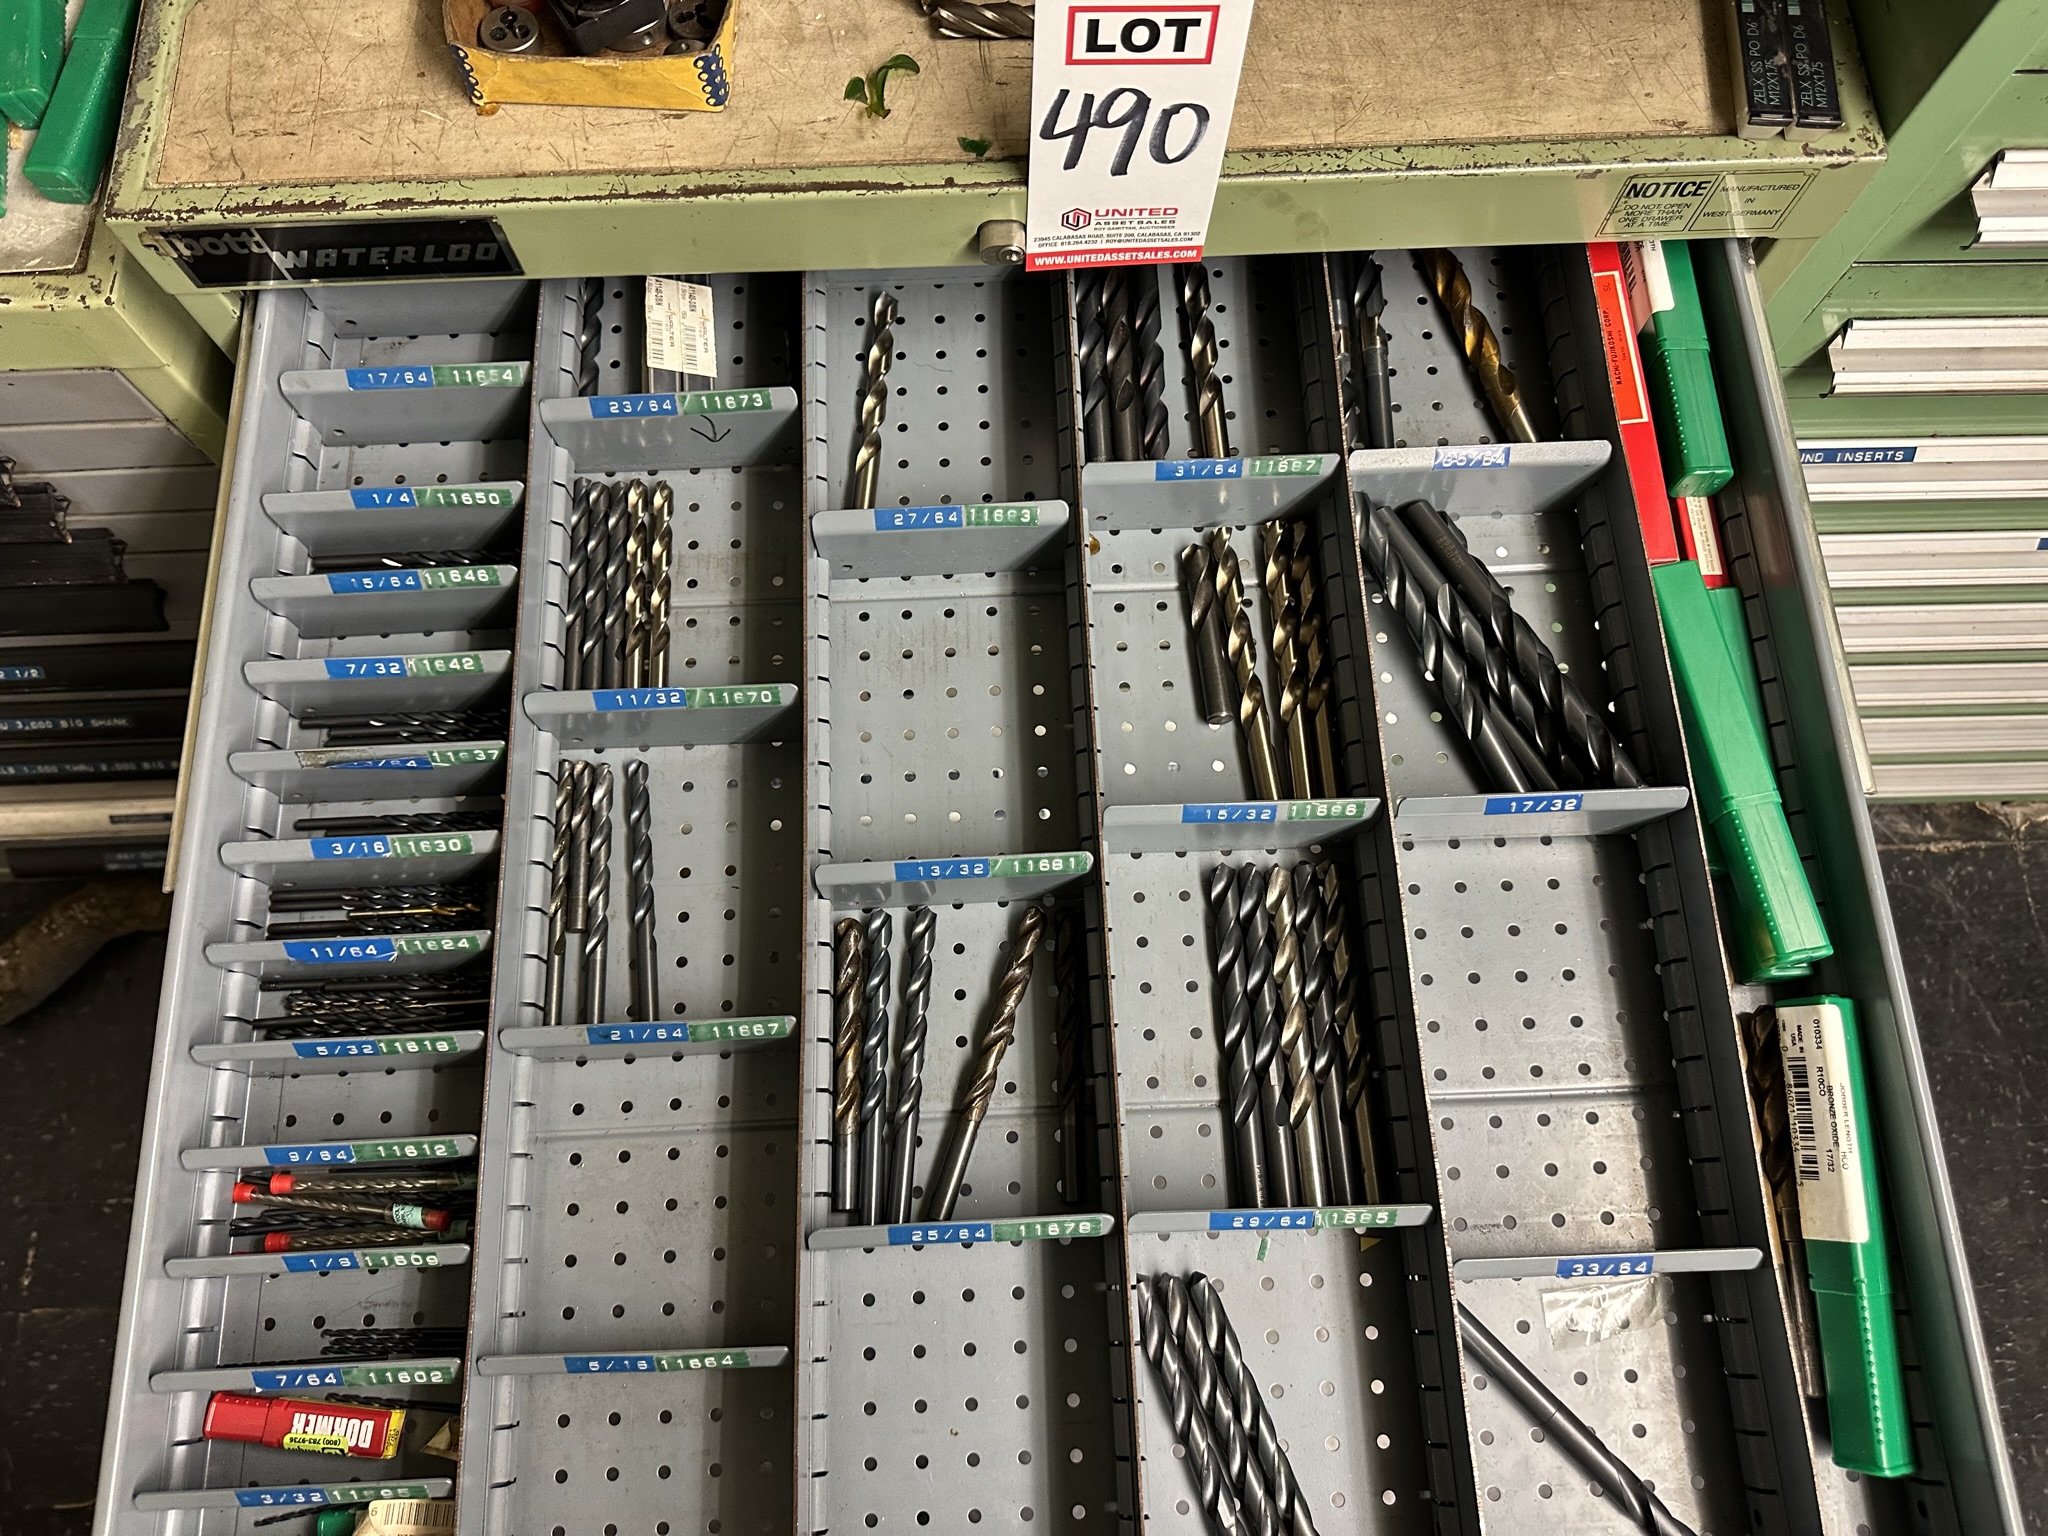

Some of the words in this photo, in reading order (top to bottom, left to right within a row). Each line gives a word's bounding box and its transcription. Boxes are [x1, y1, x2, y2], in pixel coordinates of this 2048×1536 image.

[1085, 18, 1202, 53] LOT
[1746, 21, 1759, 36] D6
[1793, 24, 1805, 39] D6
[1748, 40, 1760, 57] PO
[1795, 43, 1808, 59] PO
[1751, 61, 1762, 73] SS
[1797, 64, 1811, 76] SS
[1765, 59, 1781, 105] M12X1.75
[1811, 61, 1828, 108] M12X1.75
[1753, 78, 1767, 105] ZELX
[1800, 80, 1814, 107] ZELX
[1038, 87, 1210, 177] 490
[1625, 180, 1712, 198] NOTICE
[1720, 184, 1801, 192] MANUFACTURED
[1094, 207, 1179, 217] UNITED
[1641, 214, 1684, 222] DRAWER
[1733, 209, 1782, 217] GERMANY
[272, 243, 499, 269] WATERLOO
[1034, 250, 1197, 266] WWW.UNITEDASSETSALES.COM
[1603, 307, 1612, 327] CORP.
[1608, 330, 1623, 385] NACHI-FUJIKOSHI
[367, 372, 428, 384] 17/64
[609, 399, 672, 413] 23/64
[701, 394, 763, 409] 11673
[1835, 451, 1904, 462] INSERTS
[1175, 463, 1237, 477] 31/64
[372, 492, 410, 504] 1/4
[436, 492, 499, 504] 11650
[894, 511, 958, 525] 27/64
[351, 576, 415, 589] 15/64
[424, 570, 489, 585] 11646
[345, 662, 401, 675] 7/32
[410, 658, 475, 673] 11642
[615, 692, 680, 706] 11/32
[708, 690, 772, 704] 11670
[1510, 798, 1577, 812] 17/32
[1205, 808, 1271, 820] 15/32
[331, 841, 385, 855] 3/16
[393, 839, 461, 853] 11630
[918, 863, 984, 876] 13/32
[1013, 857, 1075, 873] 11681
[310, 944, 378, 958] 11/64
[399, 938, 470, 951] 11624
[610, 1027, 683, 1041] 21/64
[712, 1023, 779, 1038] 11667
[1796, 1024, 1804, 1043] MADE
[1812, 1018, 1823, 1050] 010334
[316, 1044, 374, 1056] 5/32
[378, 1040, 449, 1054] 11618
[1816, 1066, 1826, 1097] R10CO
[1786, 1083, 1796, 1114] 86071
[1826, 1085, 1837, 1120] BRONZE
[1839, 1082, 1849, 1118] JOBBER
[1844, 1119, 1853, 1153] LENGTH
[1830, 1121, 1840, 1148] OXIDE
[288, 1150, 348, 1162] 9/64
[376, 1144, 448, 1157] 11612
[1825, 1148, 1835, 1173] 17/32
[1232, 1216, 1307, 1227] 29/64
[911, 1228, 986, 1242] 25/64
[1019, 1221, 1091, 1237] 11678
[309, 1257, 351, 1268] 1/8
[364, 1254, 438, 1266] 11609
[1571, 1261, 1647, 1276] 33/64
[588, 1360, 648, 1371] 5/16
[660, 1355, 733, 1370] 11664
[276, 1372, 337, 1386] 7/64
[368, 1371, 444, 1383] 11602
[289, 1436, 321, 1446] 783-9736
[322, 1437, 341, 1446] (800)
[260, 1492, 323, 1504] 3/32
[370, 1507, 378, 1517] 6
